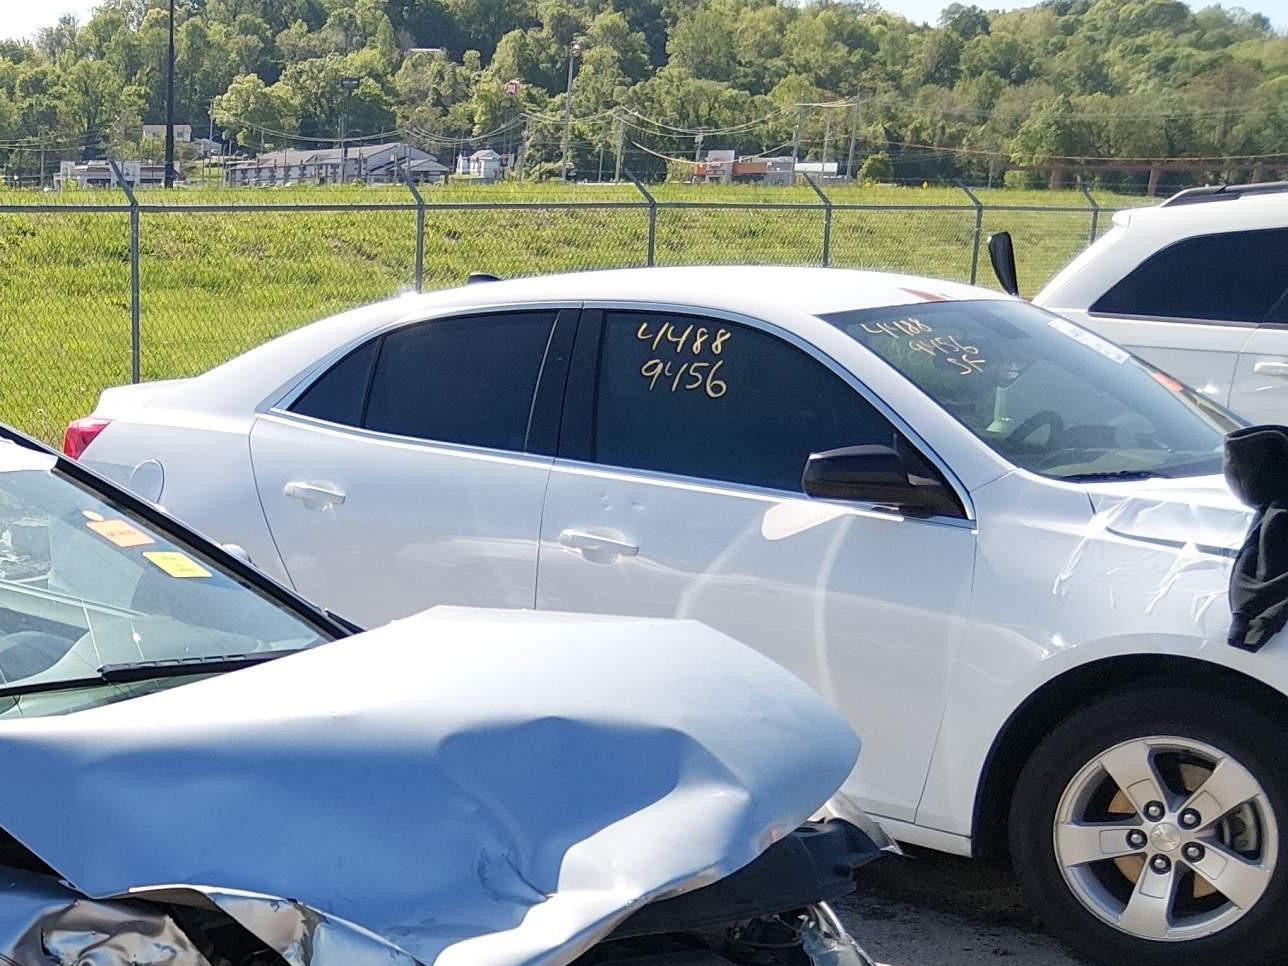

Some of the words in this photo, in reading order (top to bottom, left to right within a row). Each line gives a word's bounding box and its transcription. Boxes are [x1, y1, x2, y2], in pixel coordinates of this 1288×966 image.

[637, 322, 731, 354] 4488
[909, 335, 979, 356] 9456
[641, 359, 727, 397] 9456
